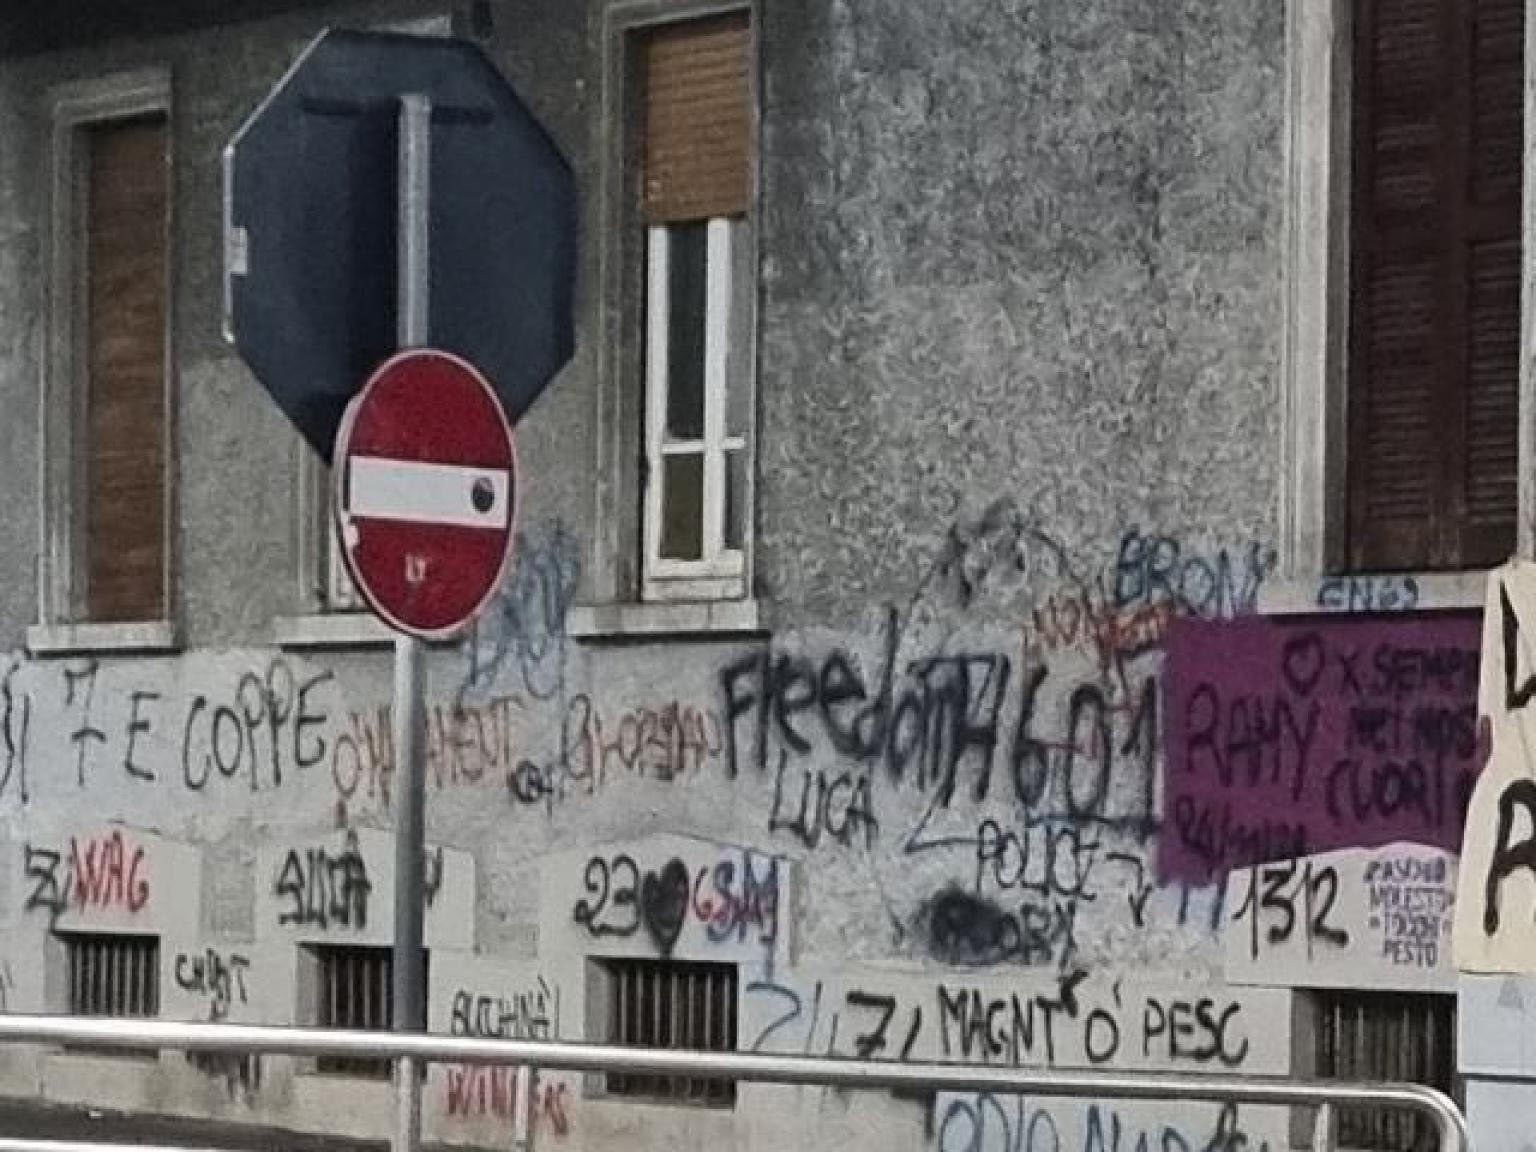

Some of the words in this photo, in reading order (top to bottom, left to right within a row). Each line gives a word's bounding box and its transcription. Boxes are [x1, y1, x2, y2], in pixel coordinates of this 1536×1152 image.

[183, 658, 335, 793] COPPE
[768, 746, 880, 852] LUCA
[1142, 998, 1252, 1066] PESC
